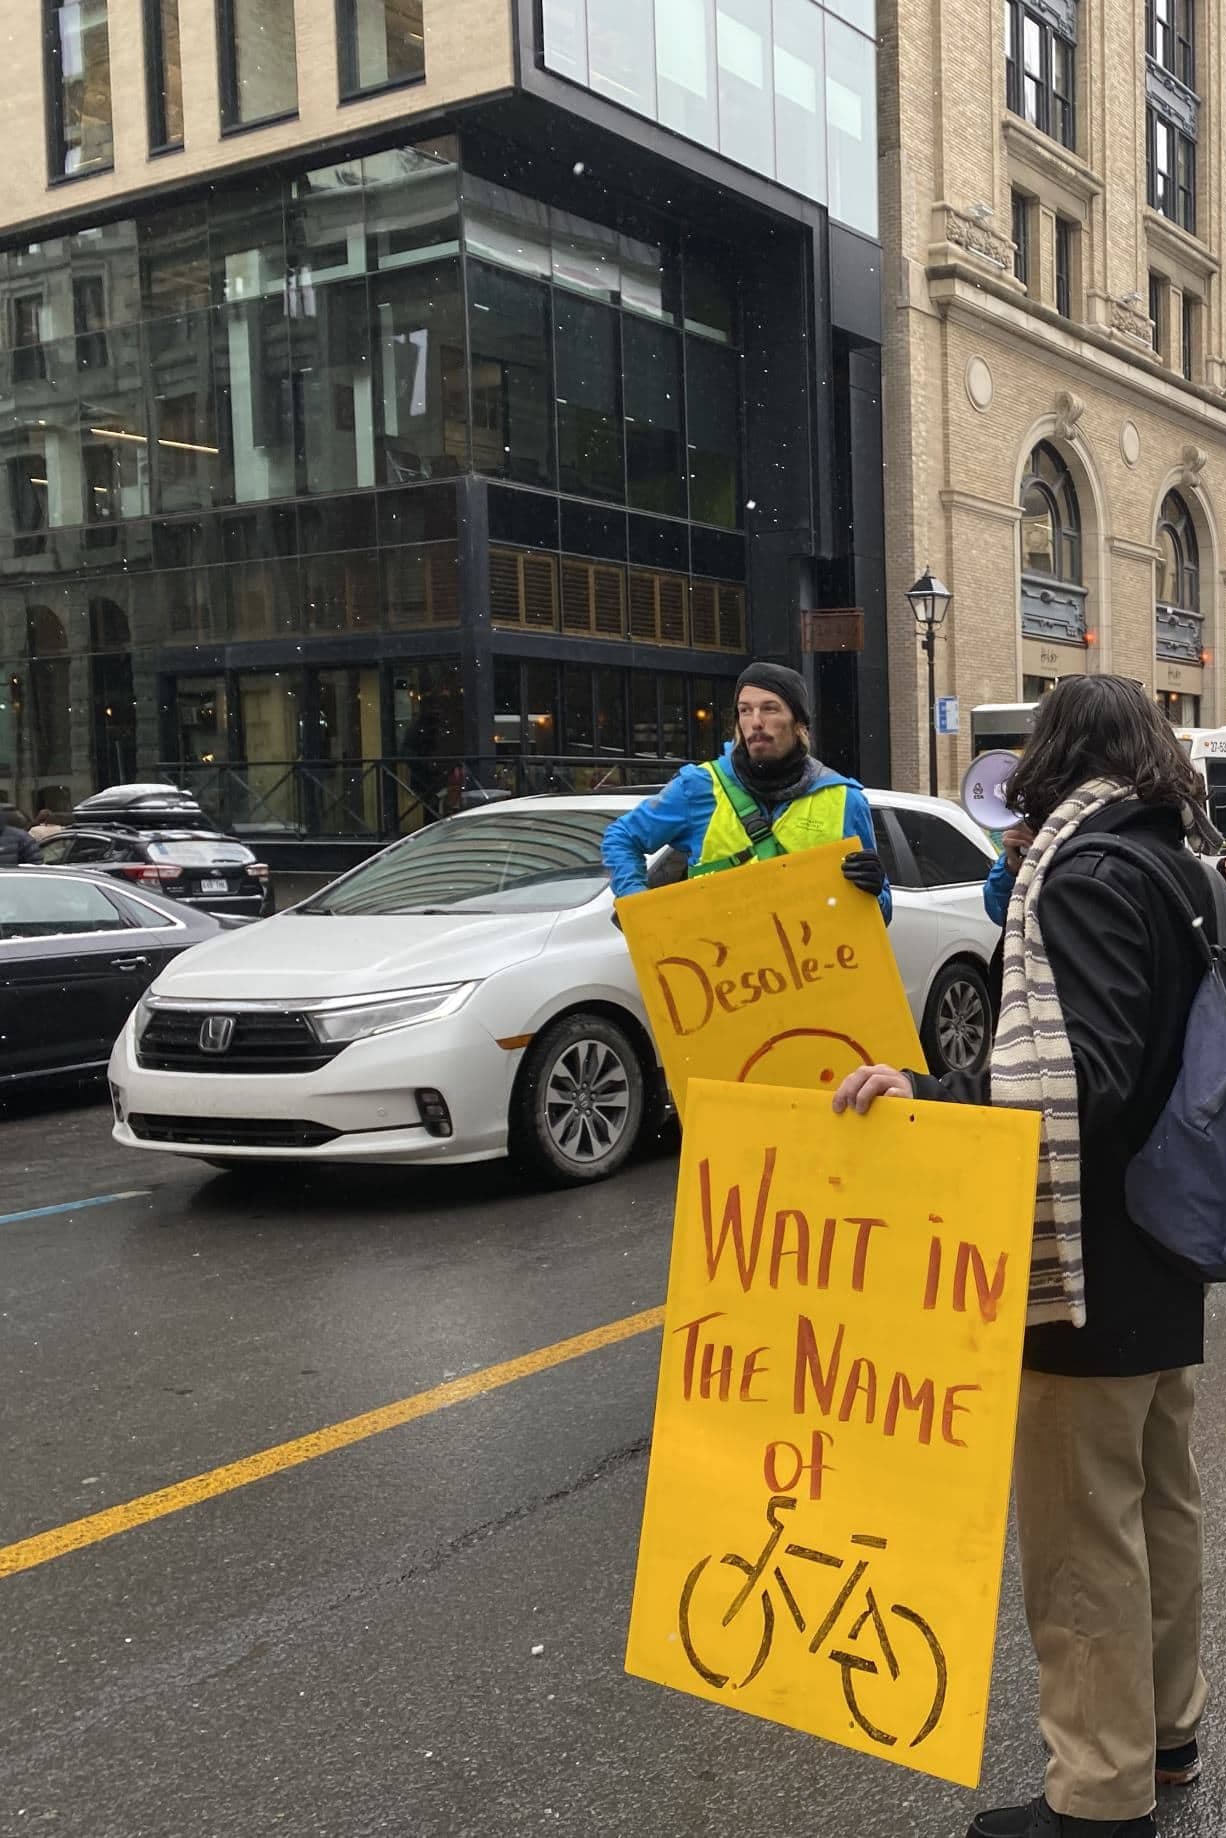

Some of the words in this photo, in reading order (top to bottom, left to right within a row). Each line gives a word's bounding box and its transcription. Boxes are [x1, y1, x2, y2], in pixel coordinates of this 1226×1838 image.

[698, 1147, 889, 1293] WAIT
[673, 1311, 770, 1402] THE
[793, 1314, 982, 1448] NAME
